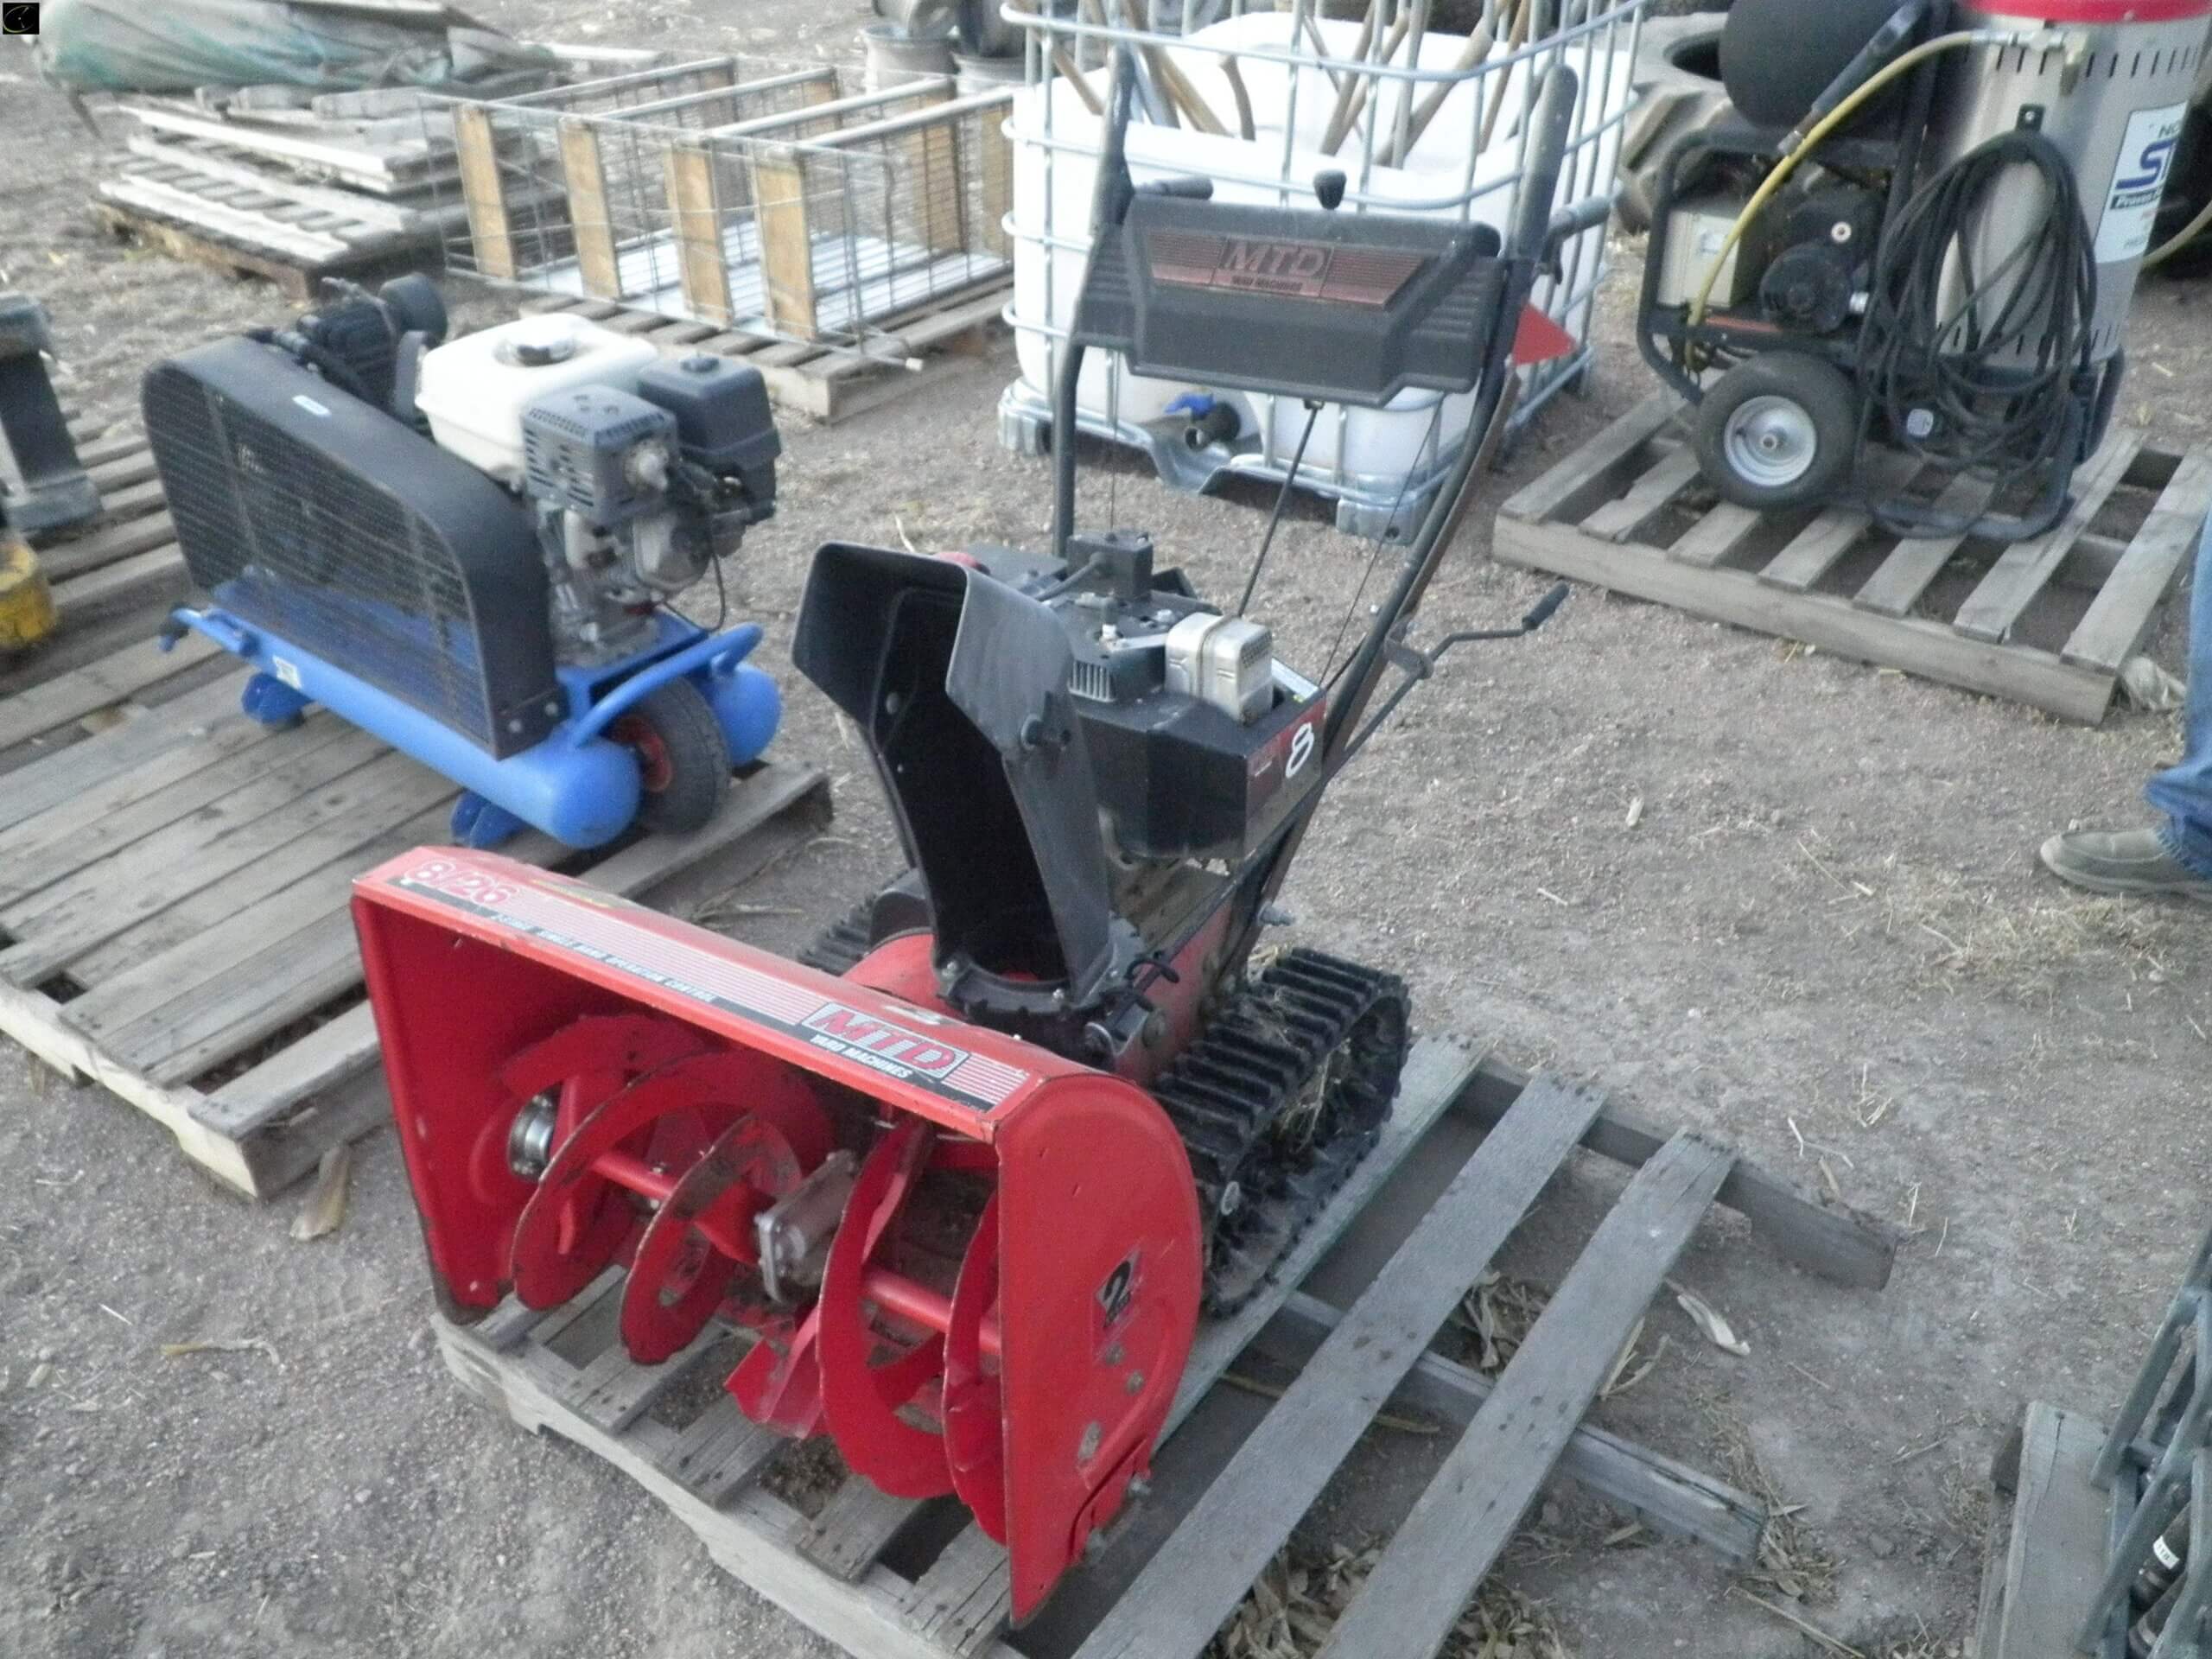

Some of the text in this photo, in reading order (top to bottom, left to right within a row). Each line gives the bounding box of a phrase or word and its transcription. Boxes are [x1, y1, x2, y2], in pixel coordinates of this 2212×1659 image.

[2115, 138, 2174, 189] S
[1219, 243, 1325, 276] MTD
[1285, 722, 1314, 779] 8
[404, 859, 518, 905] 8/26
[810, 1010, 956, 1069] MTD
[810, 1033, 912, 1078] YARD MACHINES
